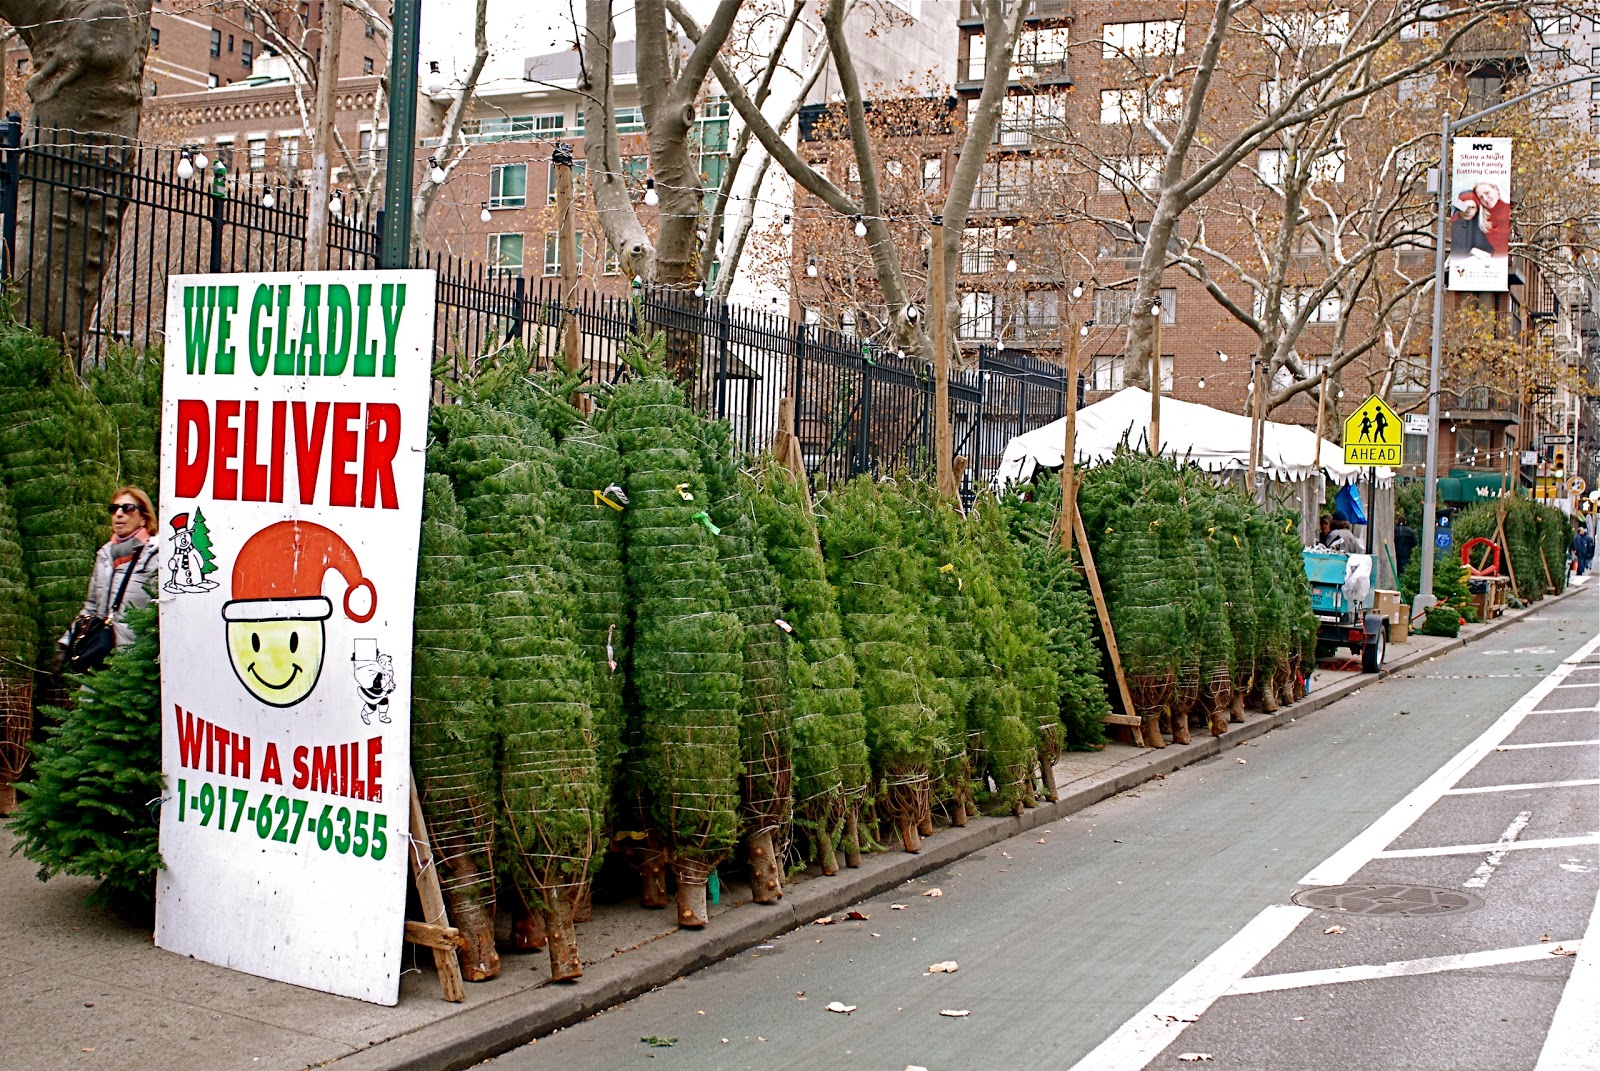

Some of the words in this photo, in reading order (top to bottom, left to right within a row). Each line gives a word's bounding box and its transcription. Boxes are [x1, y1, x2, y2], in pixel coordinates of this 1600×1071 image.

[183, 285, 240, 375] WE
[248, 283, 407, 378] GLADLY
[174, 399, 402, 510] DELIVER
[1350, 448, 1396, 461] AHEAD
[1441, 516, 1449, 527] P
[174, 703, 251, 780] WITH
[260, 742, 283, 786] A
[292, 735, 383, 804] SMILE
[177, 778, 388, 861] 1-917-627-6355
